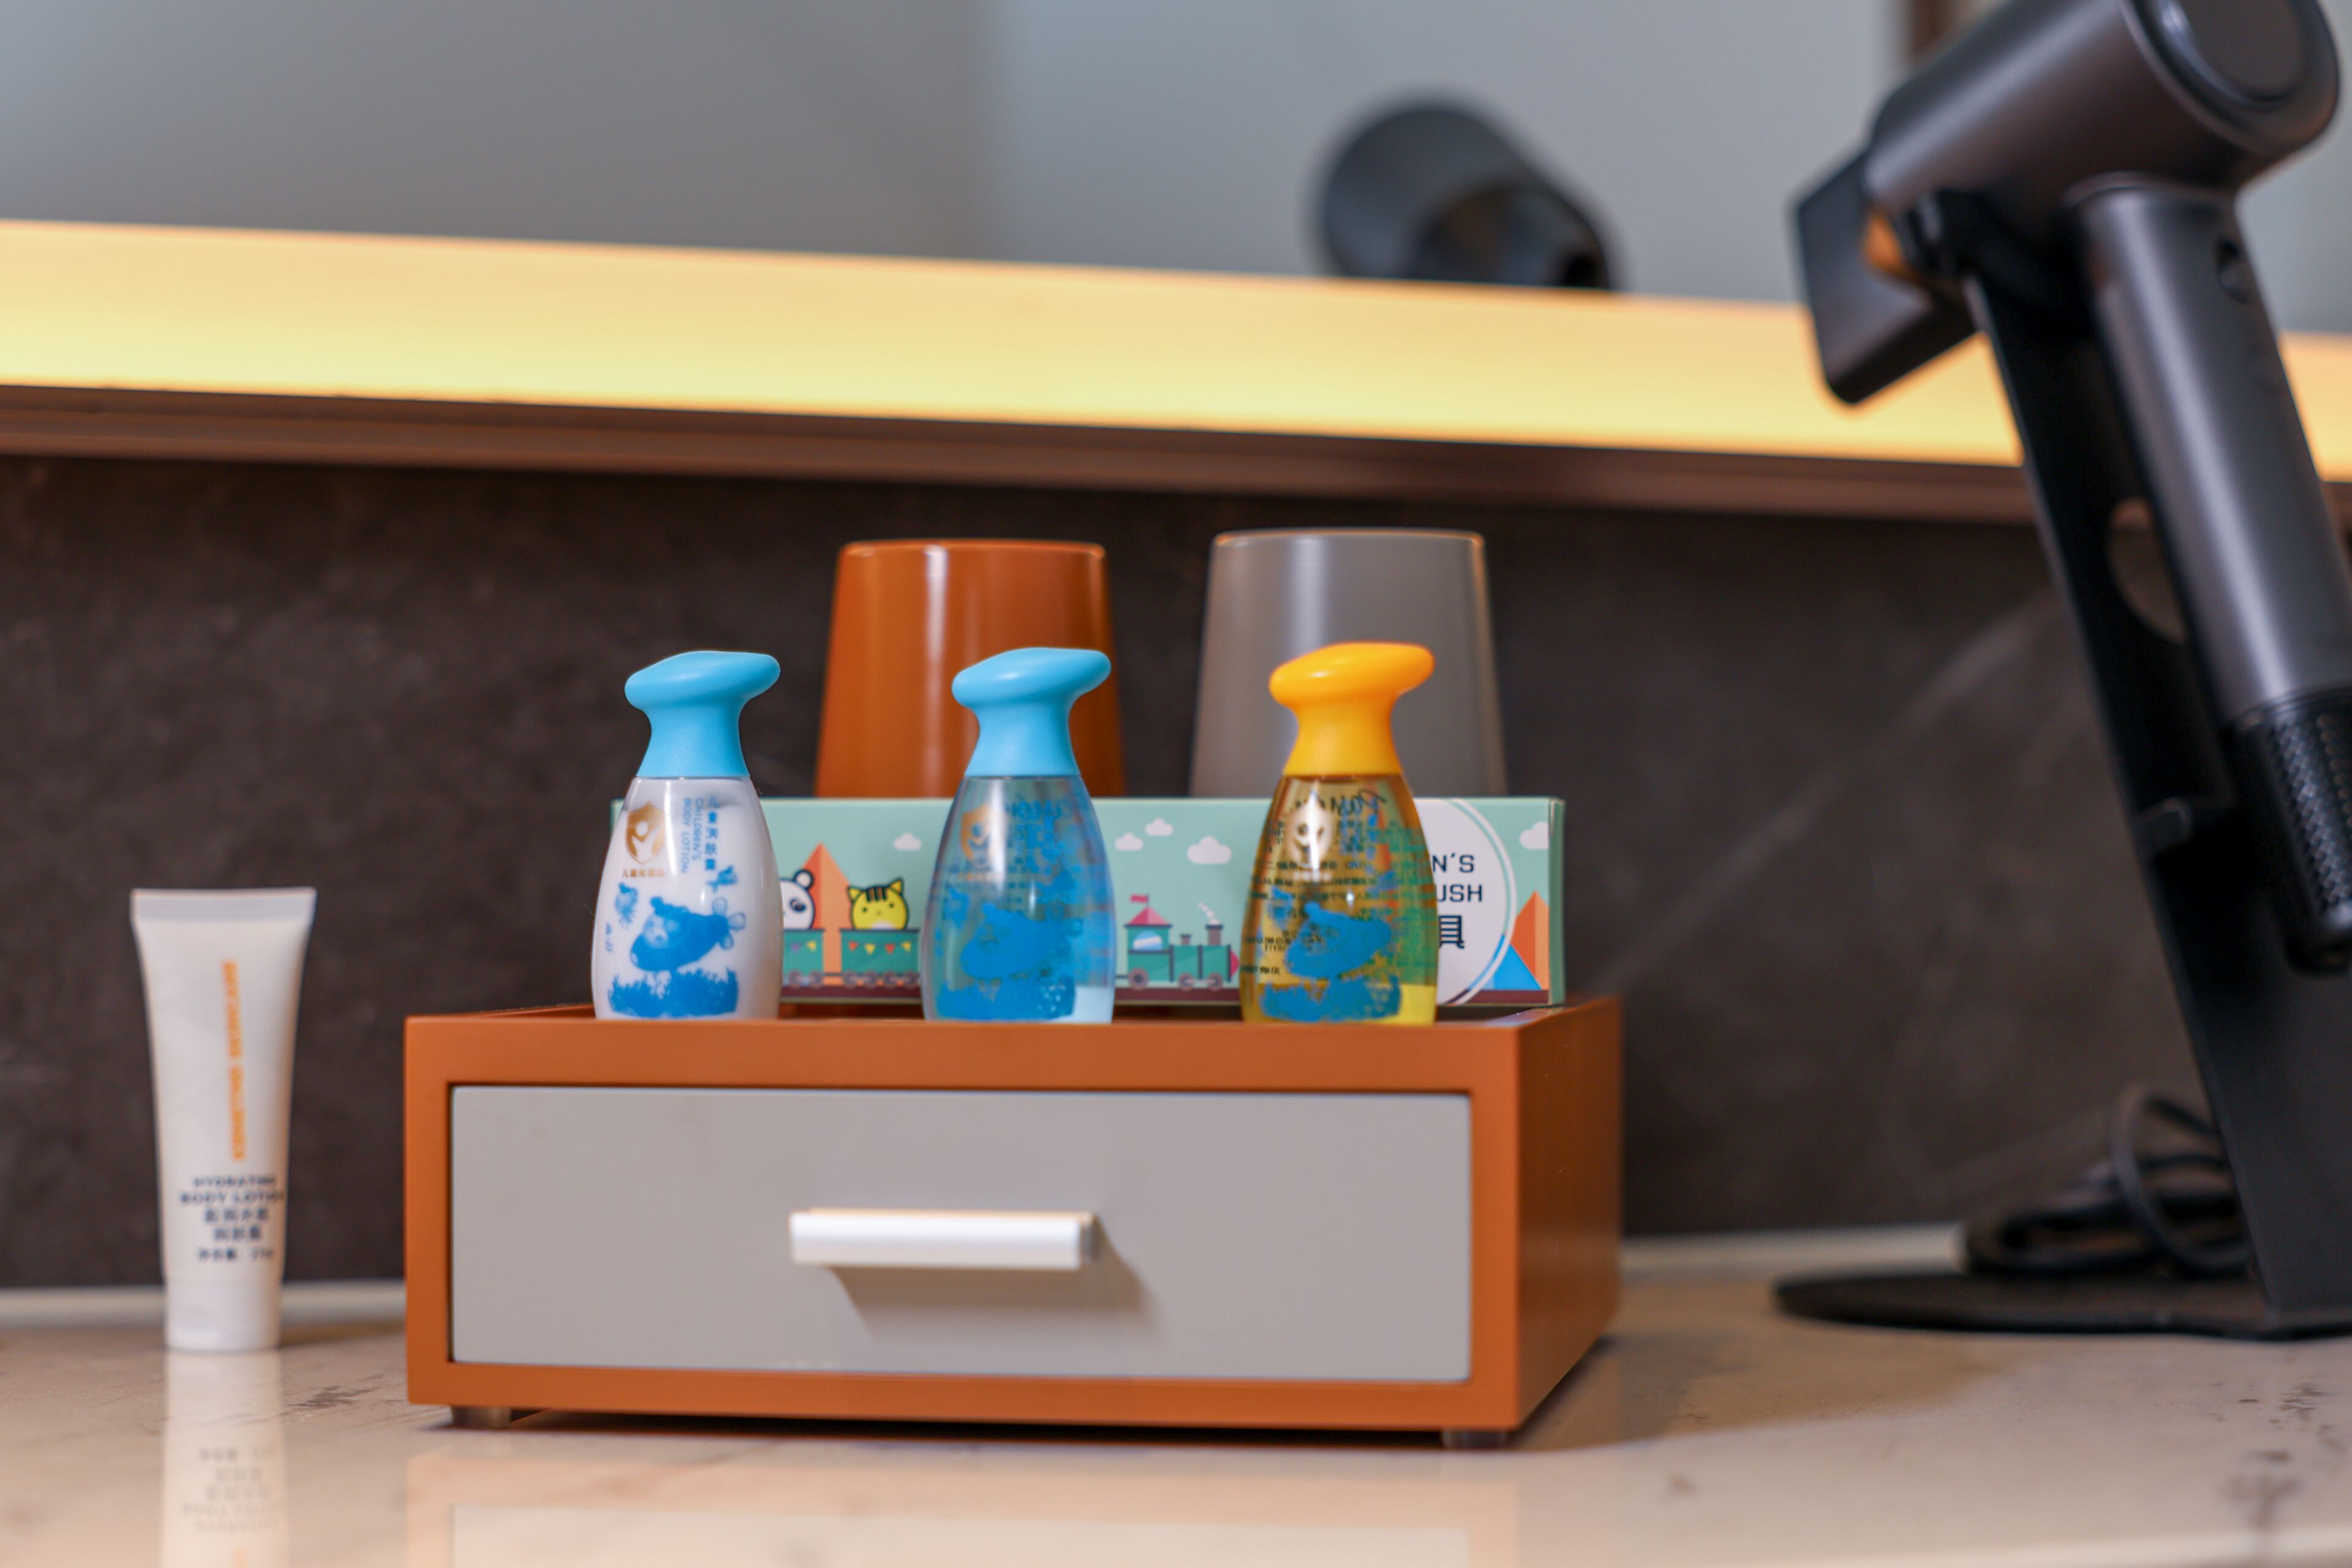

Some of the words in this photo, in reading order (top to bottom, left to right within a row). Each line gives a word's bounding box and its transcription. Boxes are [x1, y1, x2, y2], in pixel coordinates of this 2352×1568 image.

[681, 797, 692, 826] BODY
[692, 797, 703, 861] CHILDREN'S
[681, 832, 690, 873] LOTION
[1431, 853, 1474, 873] N'S
